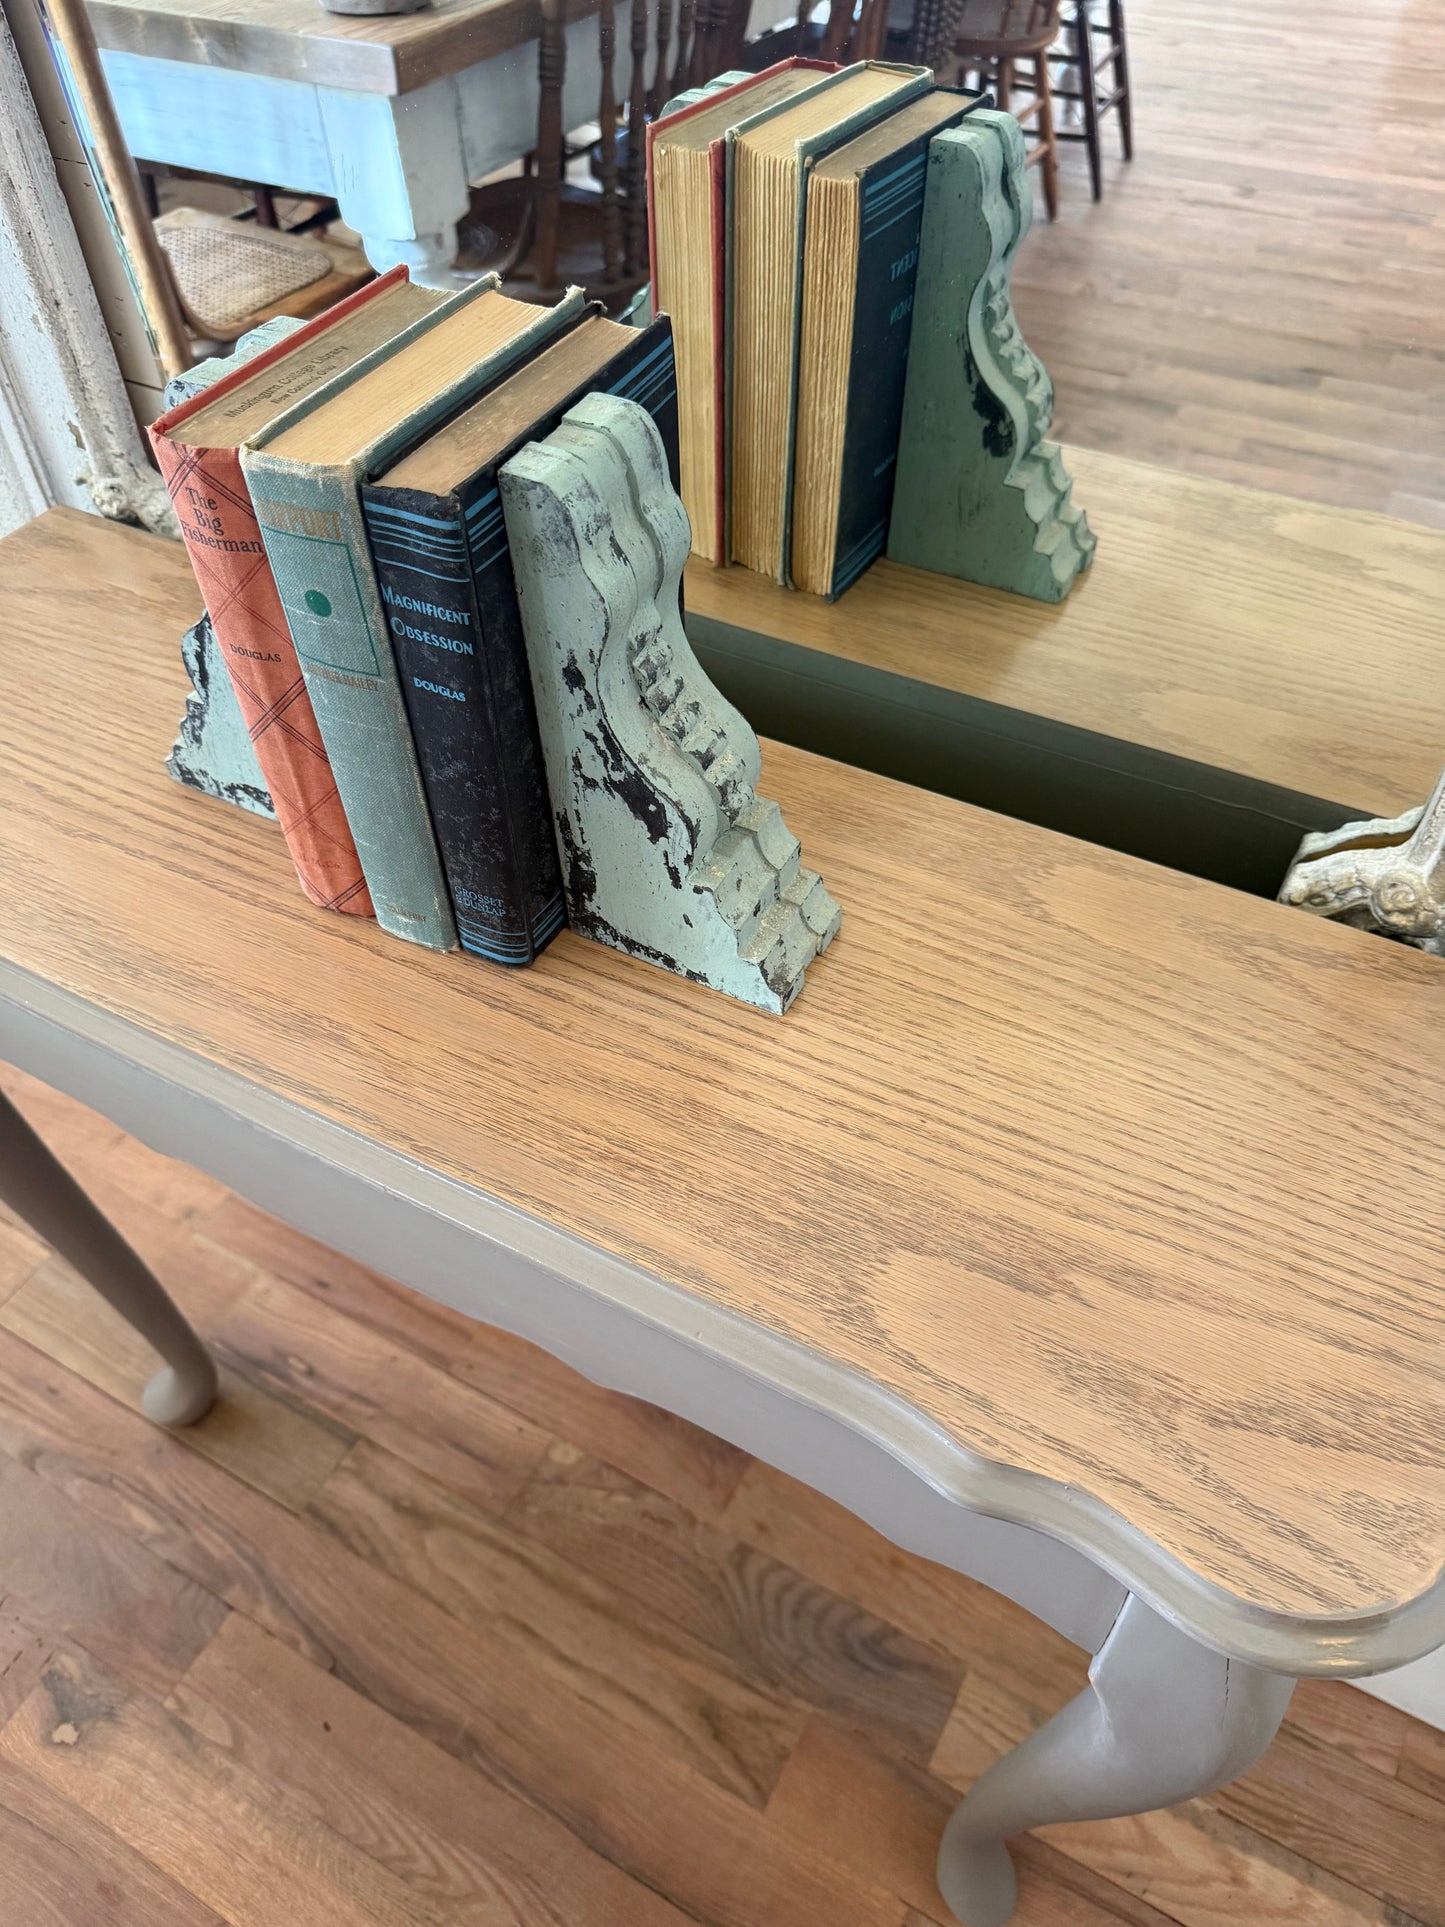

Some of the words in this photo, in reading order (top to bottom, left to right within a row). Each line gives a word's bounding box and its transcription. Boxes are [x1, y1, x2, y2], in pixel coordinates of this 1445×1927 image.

[224, 384, 283, 418] Muskingum
[279, 364, 316, 385] College
[311, 345, 350, 364] Library
[270, 393, 291, 404] New
[185, 487, 219, 510] The
[194, 508, 225, 536] Big
[258, 497, 342, 541] RPORT
[180, 519, 264, 553] Fisherman
[381, 582, 471, 625] MAGNIFICENT
[390, 616, 474, 656] OBSESSION
[230, 643, 282, 663] DOUGLAS
[413, 677, 467, 702] DOUGLAS
[454, 885, 504, 908] GROSSET
[464, 898, 507, 917] DUNLAP
